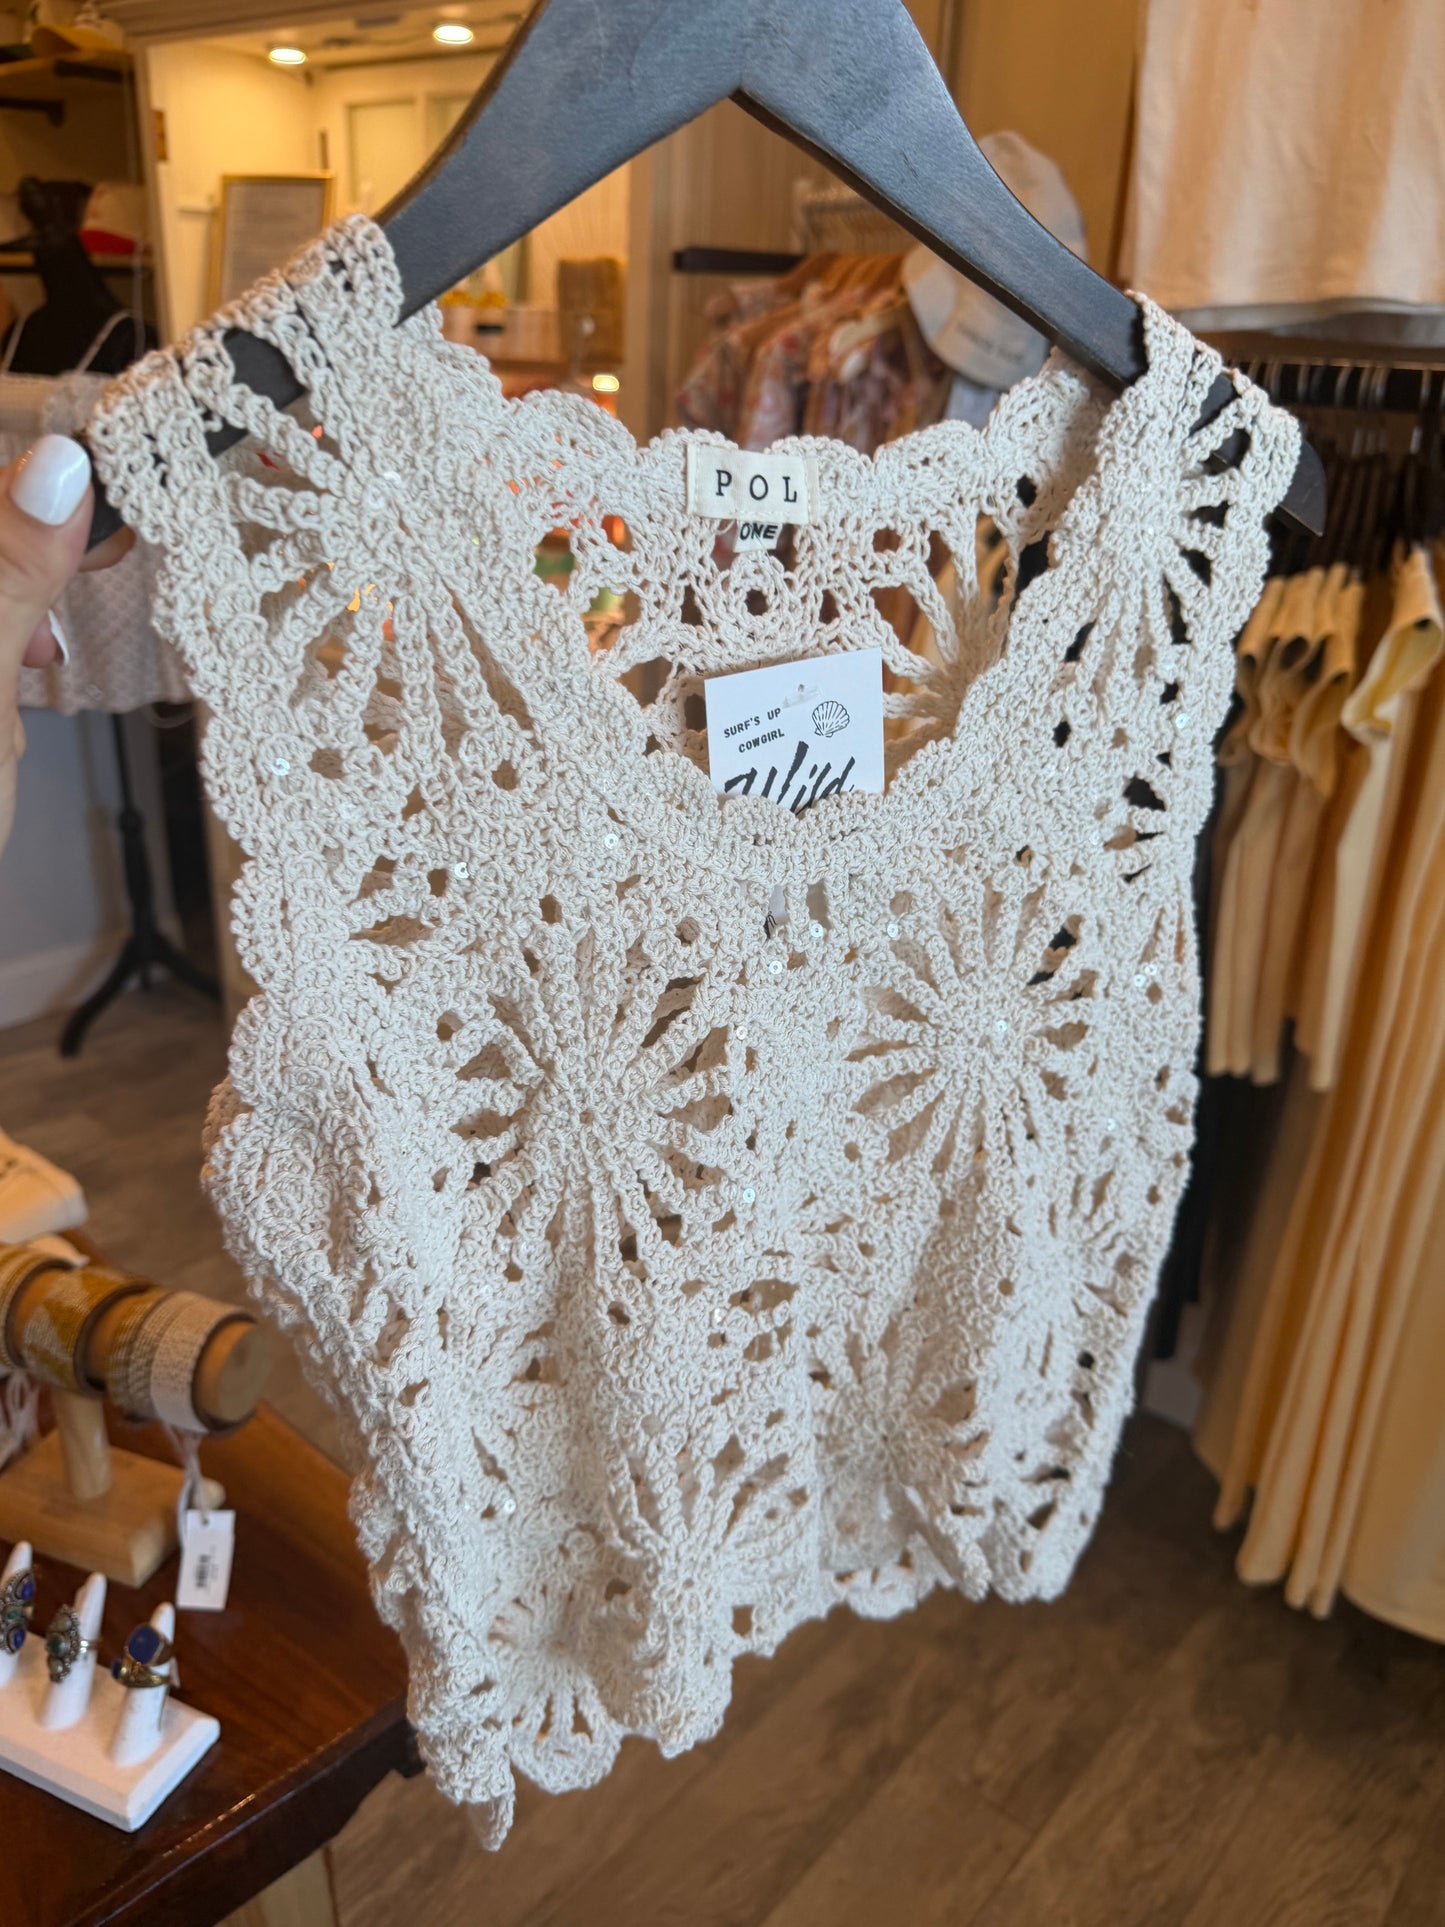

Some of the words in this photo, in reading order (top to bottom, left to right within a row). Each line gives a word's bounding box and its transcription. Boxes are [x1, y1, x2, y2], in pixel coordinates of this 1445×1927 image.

[740, 522, 779, 541] ONE
[723, 716, 761, 738] SURF'S
[767, 707, 781, 721] UP
[738, 728, 785, 753] COWGIRL
